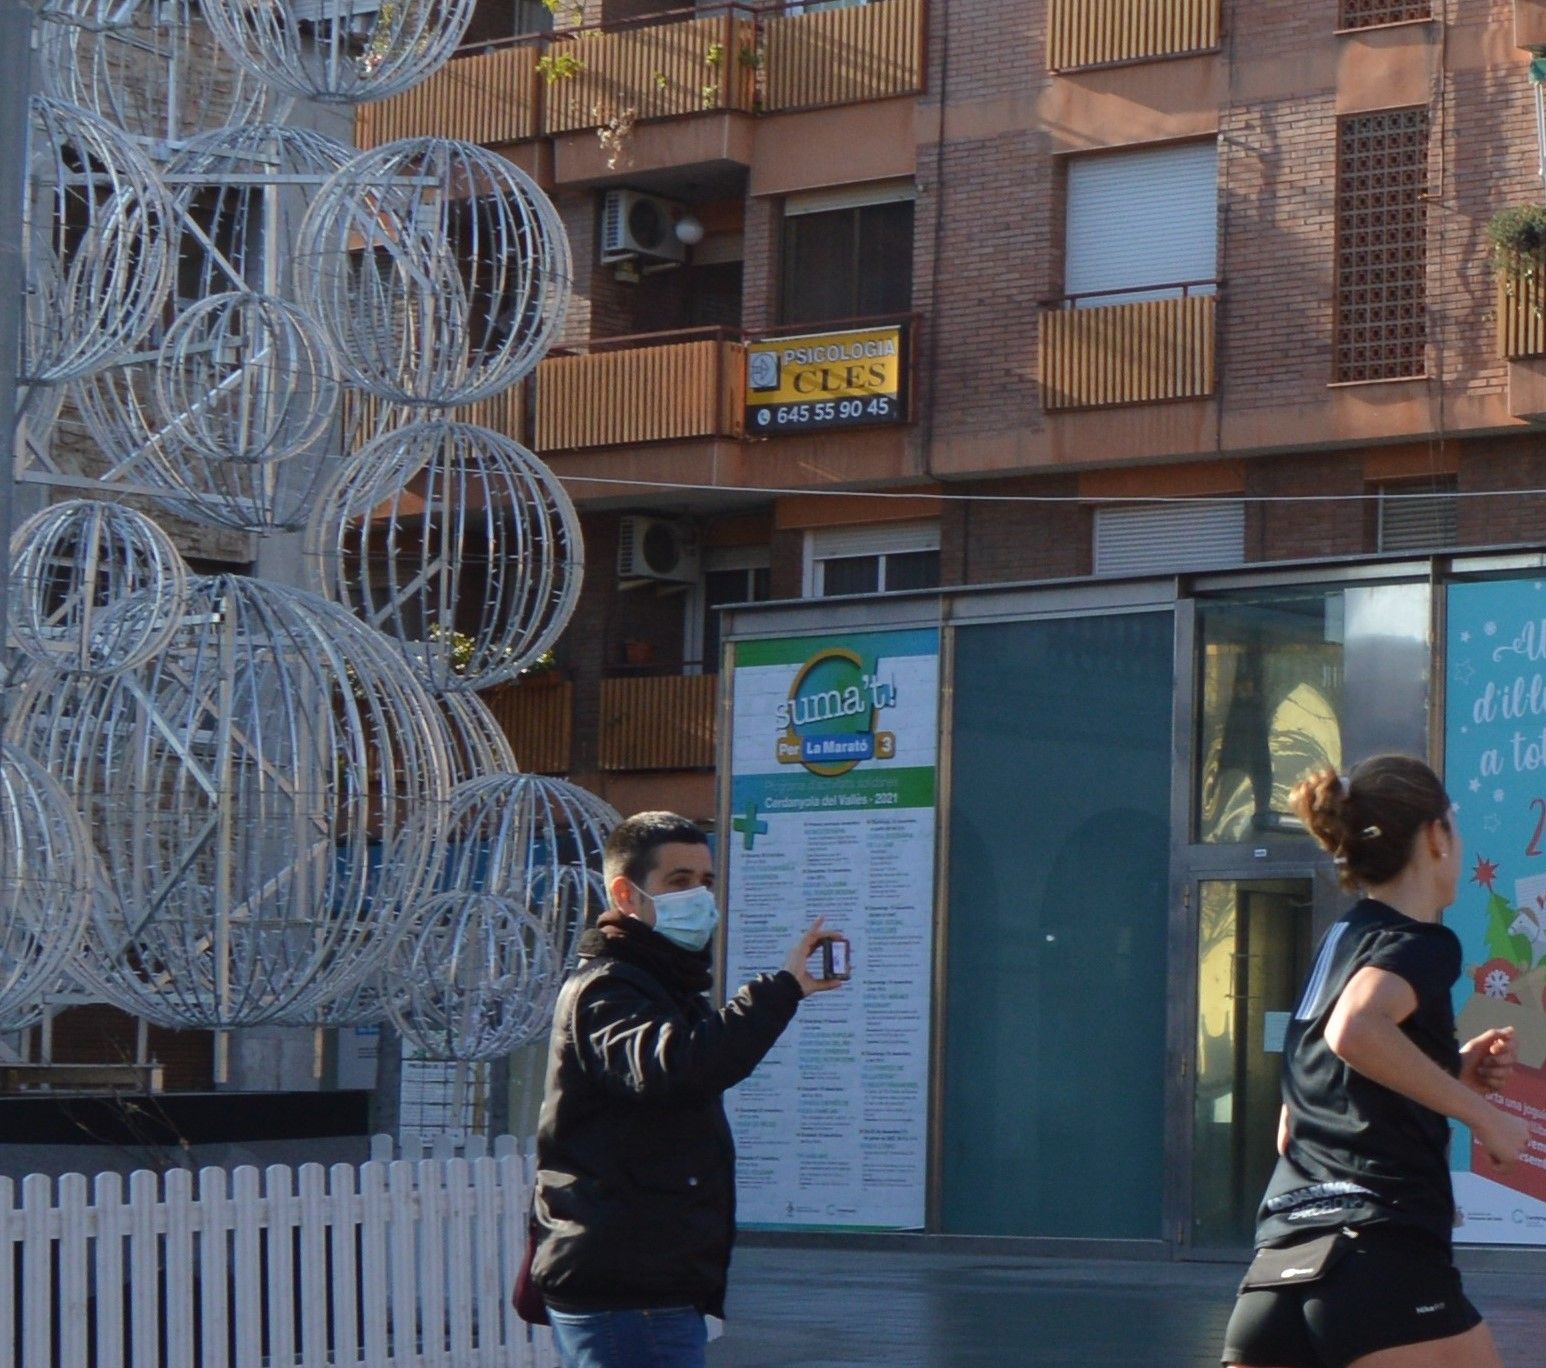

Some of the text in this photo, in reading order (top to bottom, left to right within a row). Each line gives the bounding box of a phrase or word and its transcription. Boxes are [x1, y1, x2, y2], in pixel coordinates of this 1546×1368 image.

[784, 339, 895, 365] PSICOLOGIA
[793, 363, 886, 393] CLES
[777, 398, 889, 424] 645 55 90 45
[776, 673, 896, 730] suma't!
[779, 737, 892, 755] Per La Marató 3
[1480, 749, 1503, 777] a
[766, 797, 820, 810] Cerdanyola
[822, 796, 836, 807] del
[839, 794, 868, 806] Vallès
[875, 793, 897, 804] 2021
